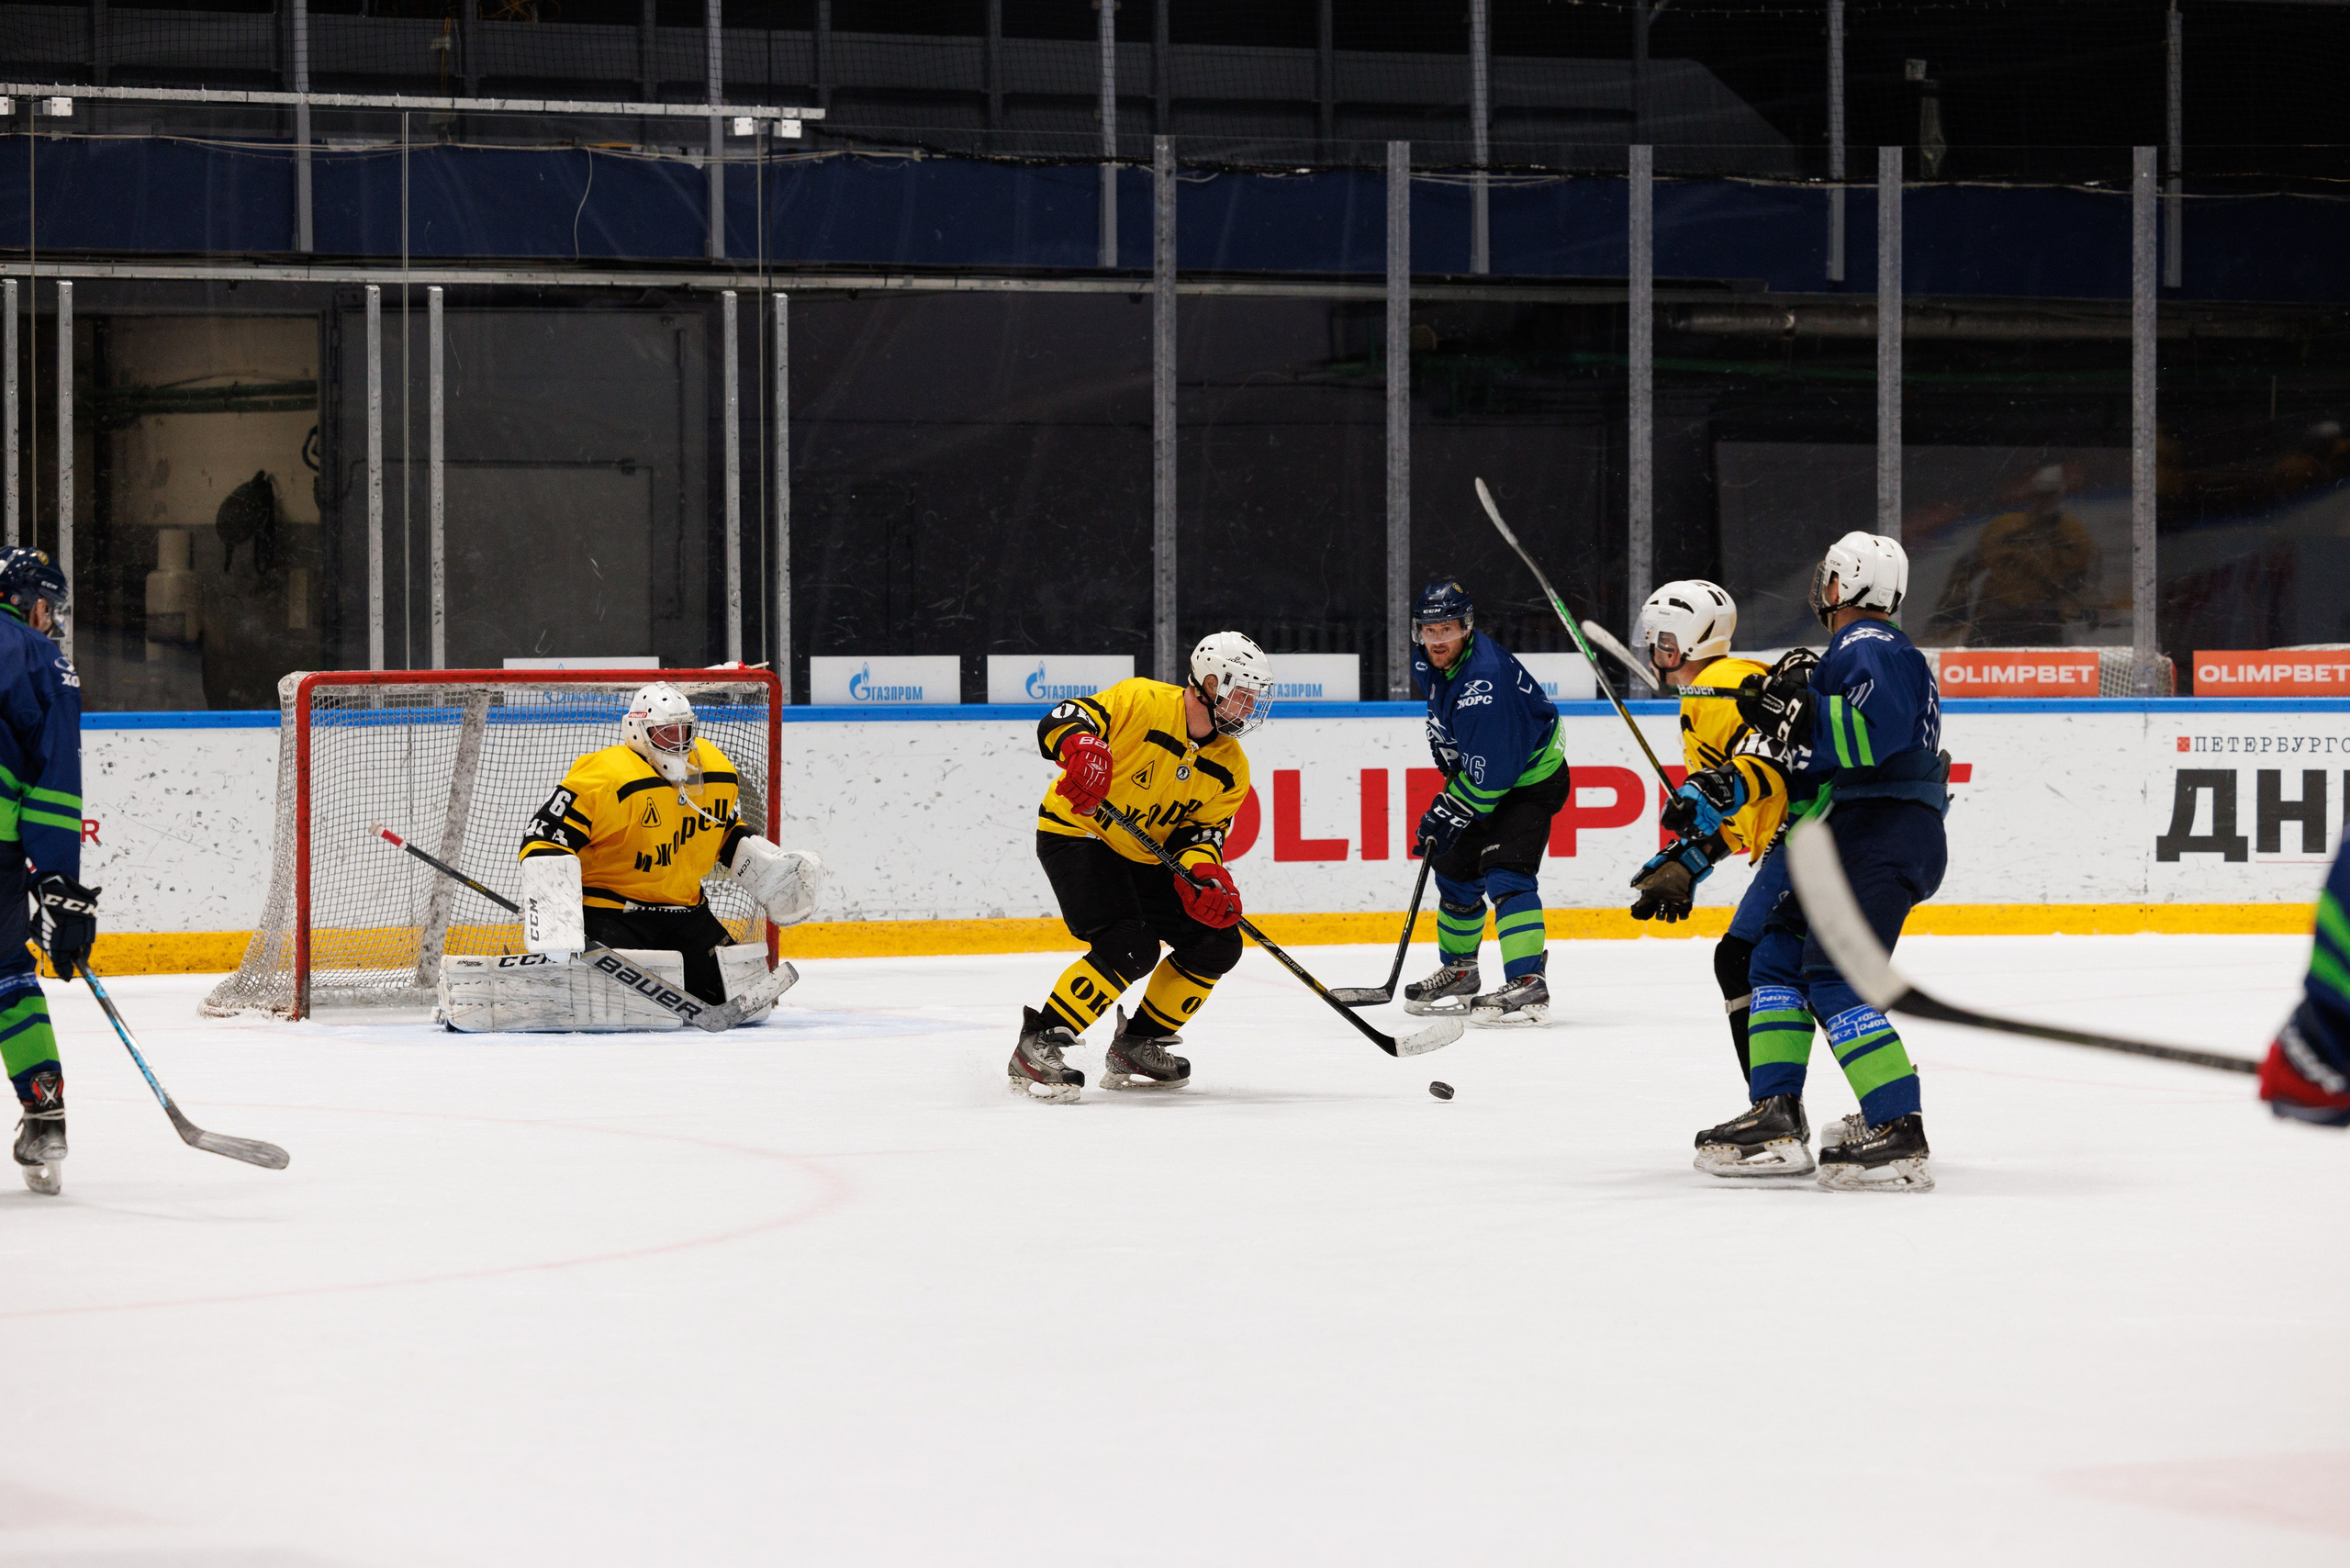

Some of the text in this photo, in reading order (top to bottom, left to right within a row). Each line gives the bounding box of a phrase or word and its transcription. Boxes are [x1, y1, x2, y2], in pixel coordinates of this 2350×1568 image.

[1943, 665, 2095, 684] OLIMPBET
[2198, 664, 2350, 683] OLIMPBET
[871, 686, 923, 700] ГАЗПРОМ
[1047, 685, 1097, 700] ГАЗПРОМ
[1273, 683, 1323, 698] ГАЗПРОМ
[1457, 695, 1494, 710] ХОРС
[1433, 804, 1471, 829] CC
[2156, 768, 2350, 862] ДН
[737, 858, 751, 878] CCM
[529, 897, 540, 942] CCM
[594, 955, 703, 1021] BAUER
